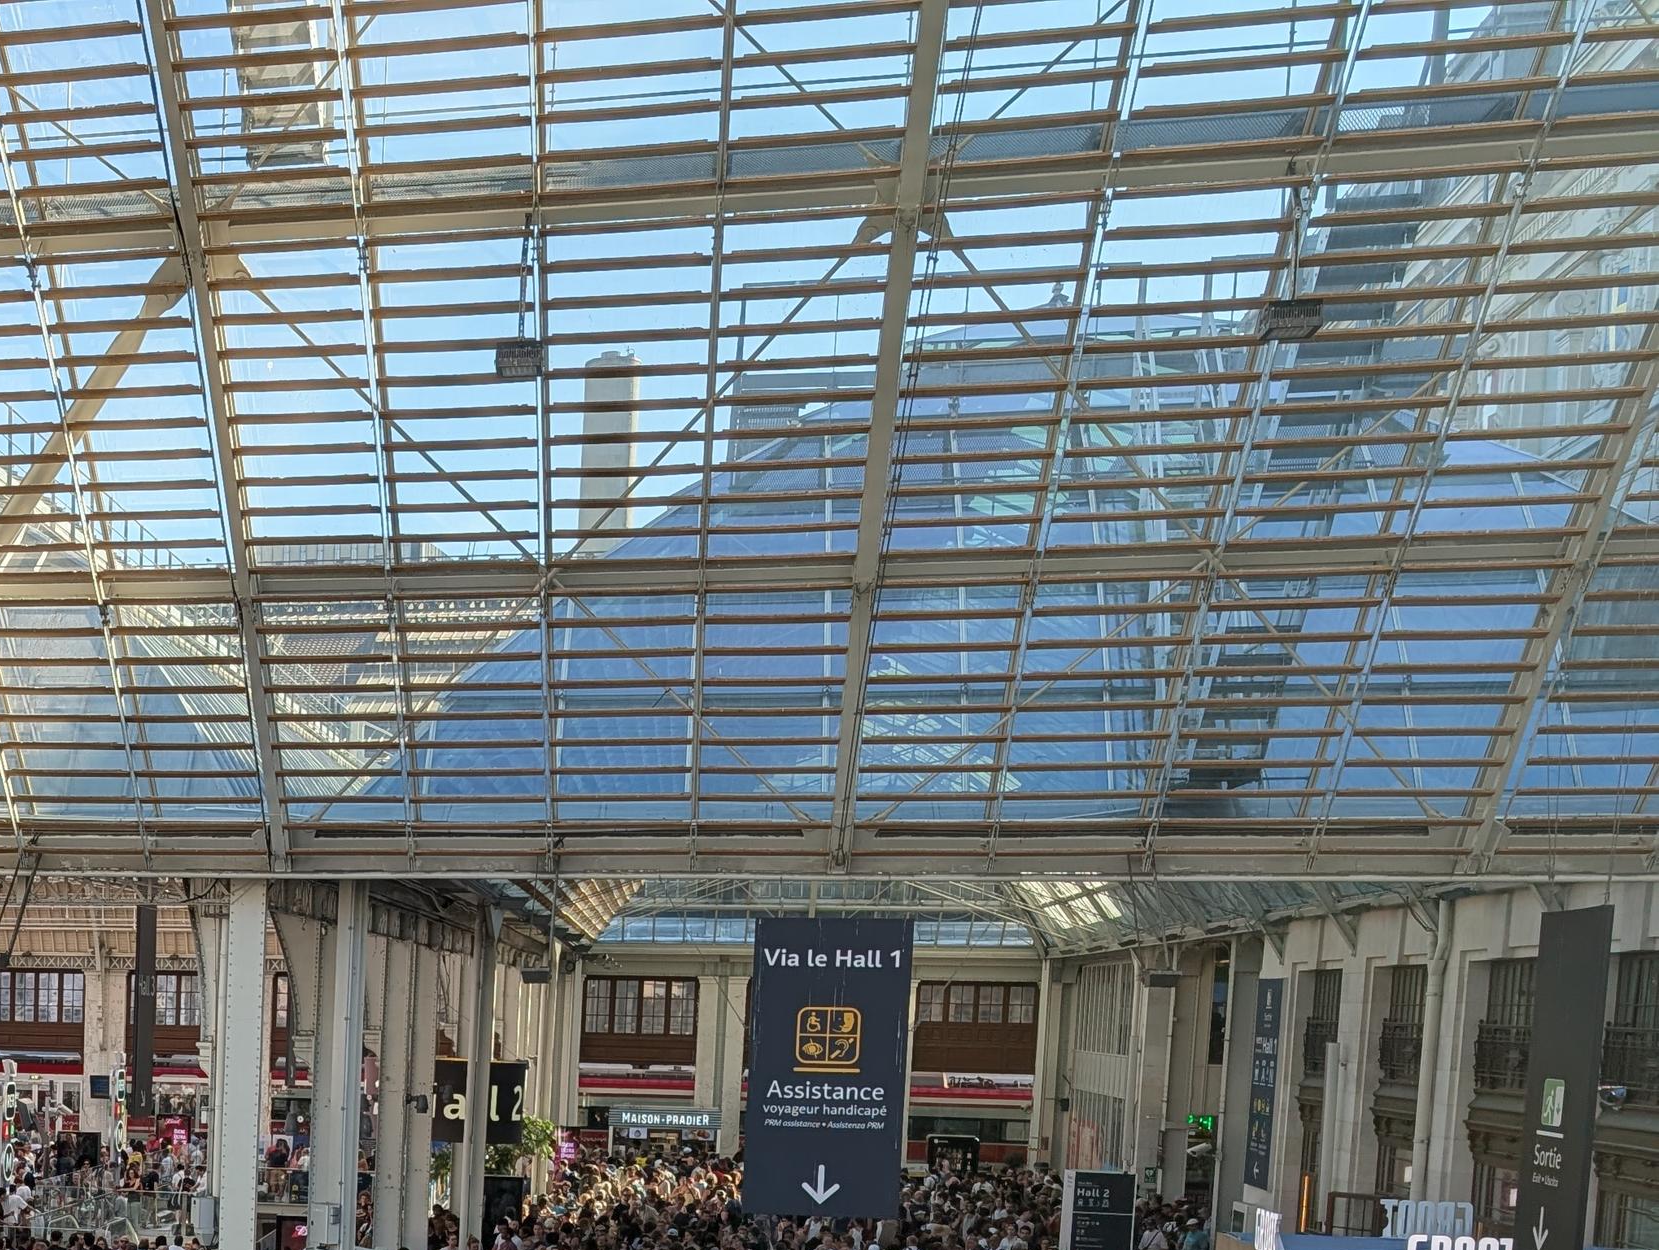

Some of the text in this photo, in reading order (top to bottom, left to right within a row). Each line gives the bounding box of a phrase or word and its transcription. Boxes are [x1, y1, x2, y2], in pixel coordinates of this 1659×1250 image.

[764, 948, 901, 968] Via le Hall 1
[767, 1080, 885, 1101] Assistance
[511, 1084, 523, 1122] 2
[763, 1104, 887, 1118] voyageur handicapé
[764, 1119, 885, 1129] PRM assistance Assistenza PRM
[1533, 1144, 1562, 1170] Sortie
[1077, 1188, 1110, 1198] Hall 2
